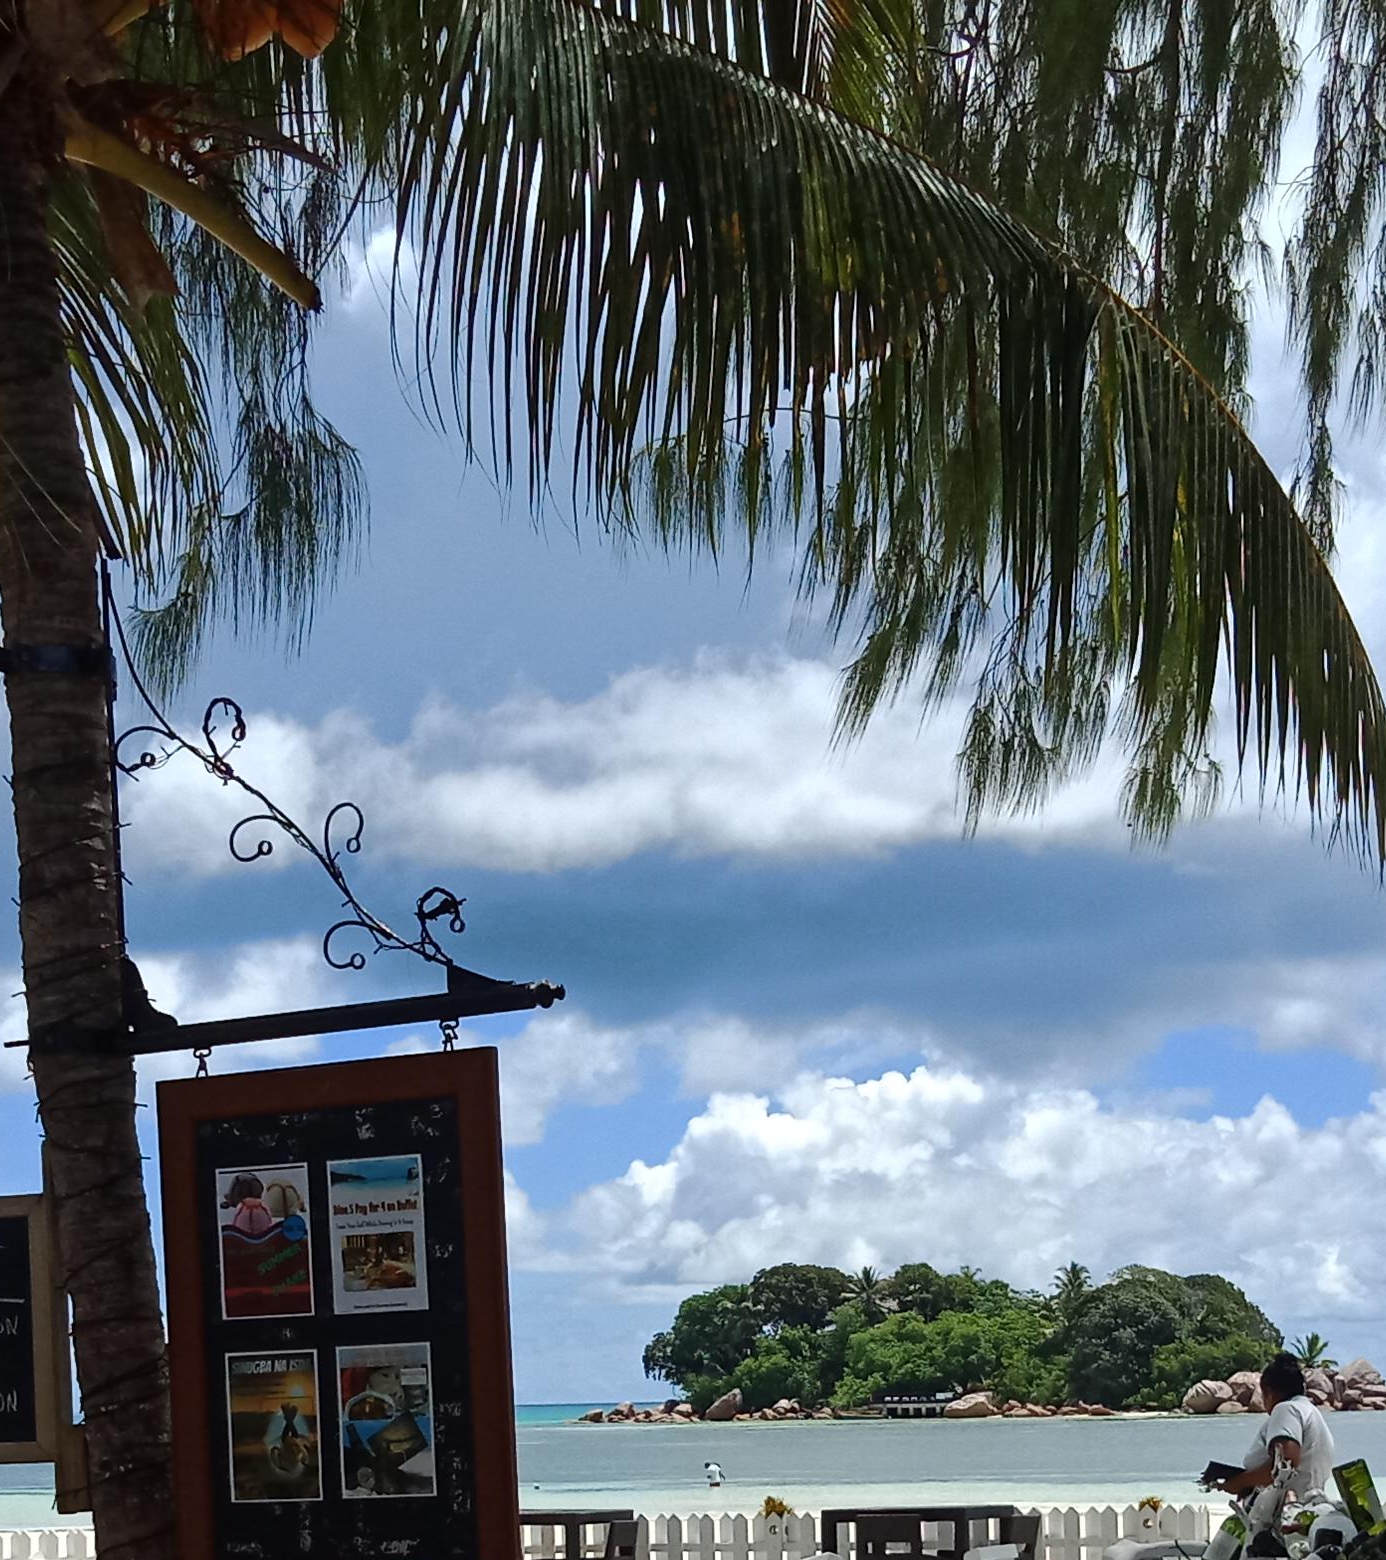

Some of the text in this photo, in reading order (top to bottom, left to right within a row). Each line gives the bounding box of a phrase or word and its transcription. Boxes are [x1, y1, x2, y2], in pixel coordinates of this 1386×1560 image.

[369, 1200, 380, 1213] for
[381, 1201, 386, 1212] 4
[387, 1202, 396, 1212] on
[274, 1359, 287, 1373] NA
